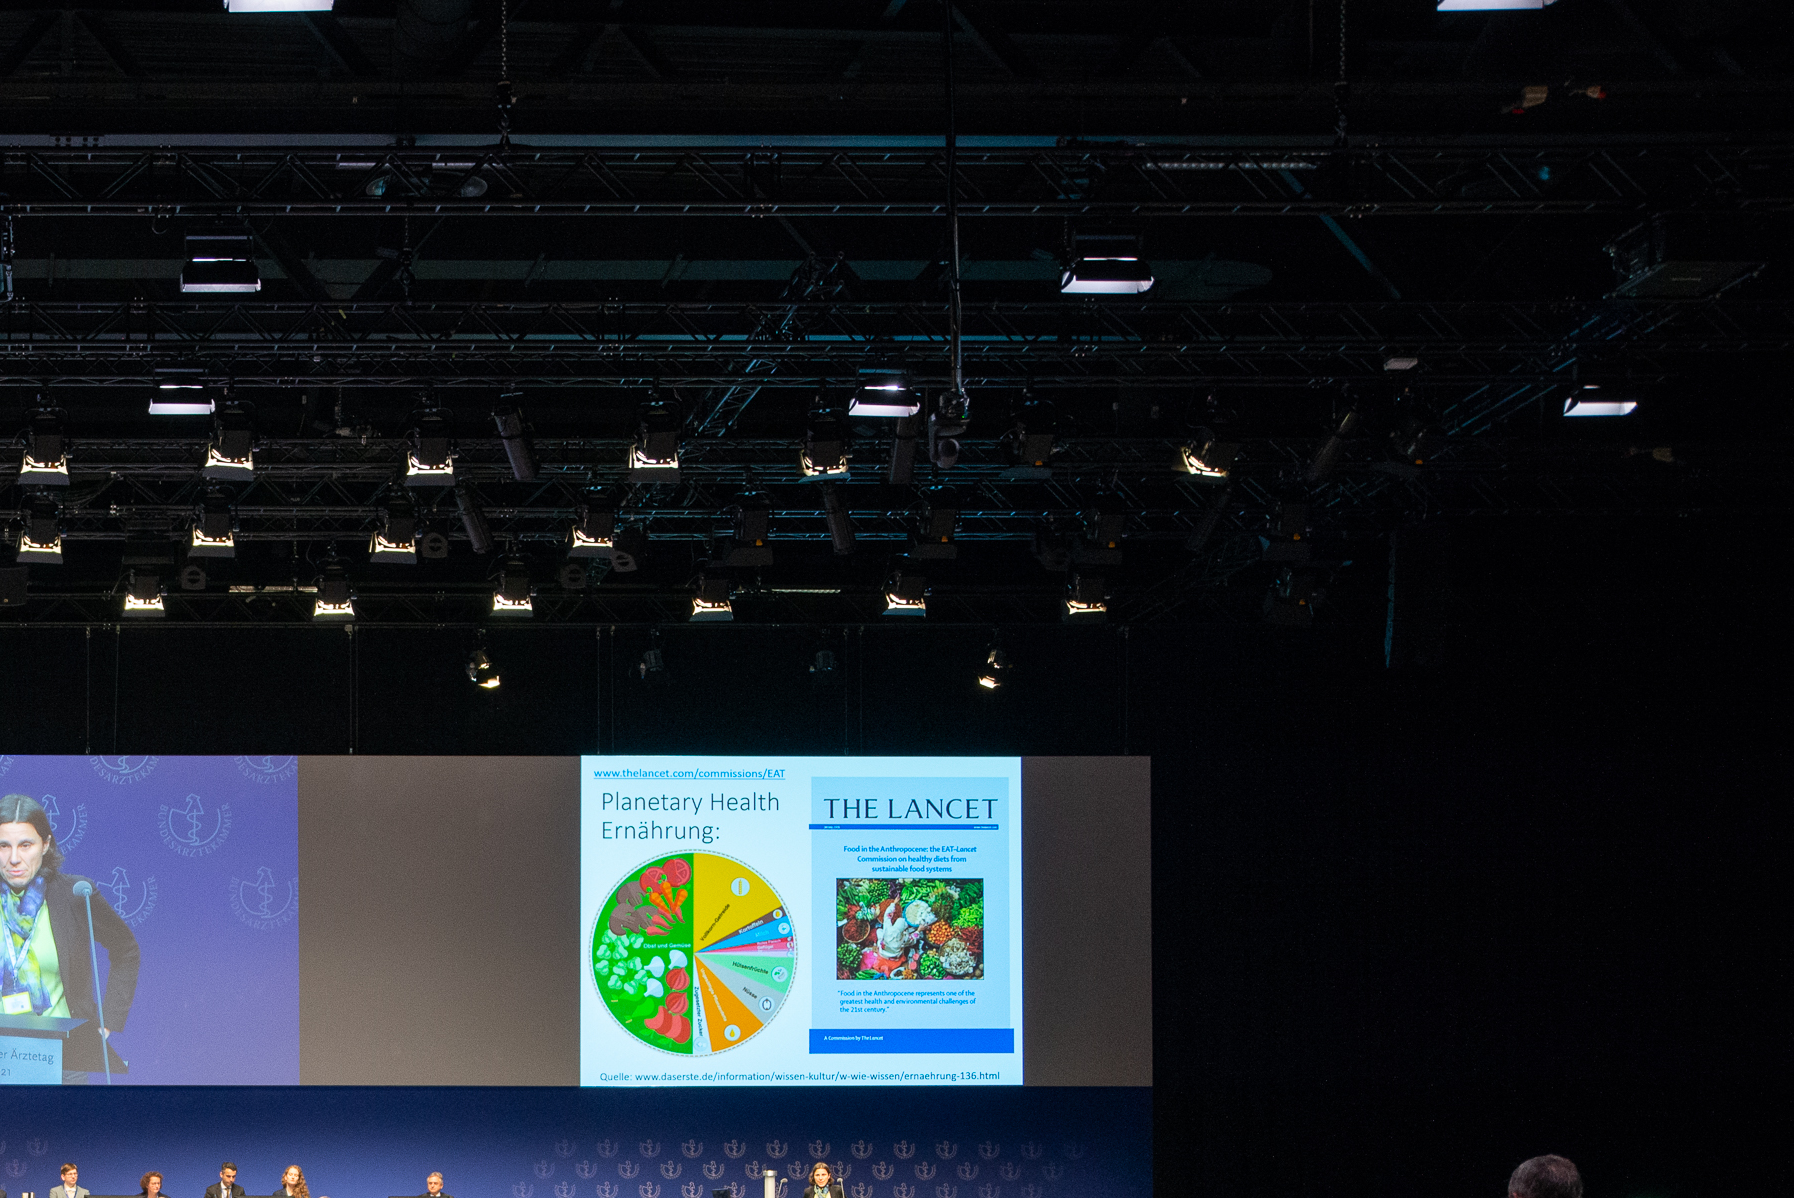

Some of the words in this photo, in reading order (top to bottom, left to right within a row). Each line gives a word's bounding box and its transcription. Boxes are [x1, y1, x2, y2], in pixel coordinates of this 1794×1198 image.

[594, 768, 785, 778] www.thelancet.com/commissions/EAT
[602, 792, 702, 815] Planetary
[710, 792, 779, 811] Health
[823, 799, 878, 819] THE
[889, 799, 999, 819] LANCET
[602, 821, 720, 844] Ernährung:
[843, 845, 860, 853] Food
[861, 845, 868, 853] in
[869, 845, 880, 853] the
[880, 845, 929, 854] Anthropocene:
[929, 845, 941, 853] the
[857, 855, 897, 863] Commission
[907, 855, 933, 864] healthy
[933, 855, 950, 863] diets
[950, 855, 967, 863] from
[871, 865, 909, 873] sustainable
[909, 865, 925, 873] food
[925, 866, 953, 874] systems
[873, 990, 915, 998] Anthropocene
[839, 998, 863, 1006] greatest
[939, 998, 969, 1006] challenges
[10, 1047, 55, 1064] Ärztetag
[599, 1072, 633, 1082] Quelle:
[635, 1071, 1000, 1082] www.daserste.de/information/wissen-kultur/w-wie-wissen/ernaehrung-136.html
